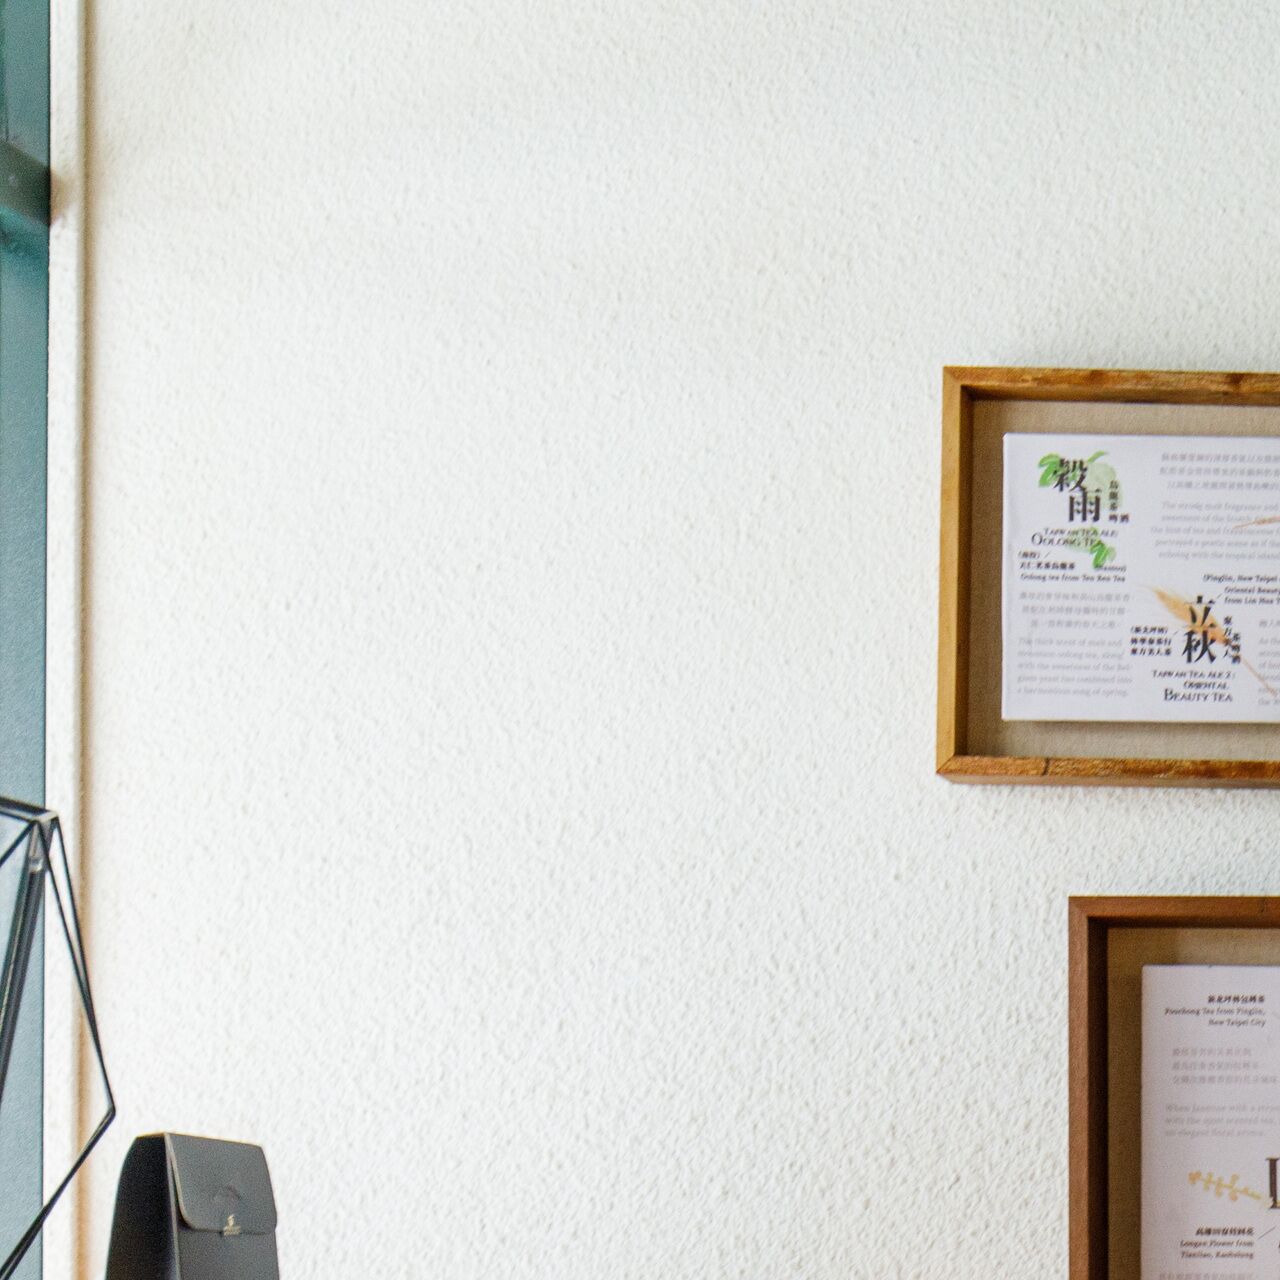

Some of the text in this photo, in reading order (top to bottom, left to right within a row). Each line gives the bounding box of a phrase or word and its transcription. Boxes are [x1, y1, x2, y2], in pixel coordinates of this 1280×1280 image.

[1182, 596, 1216, 663] 立秋
[1164, 688, 1233, 701] BEAUTY TEA
